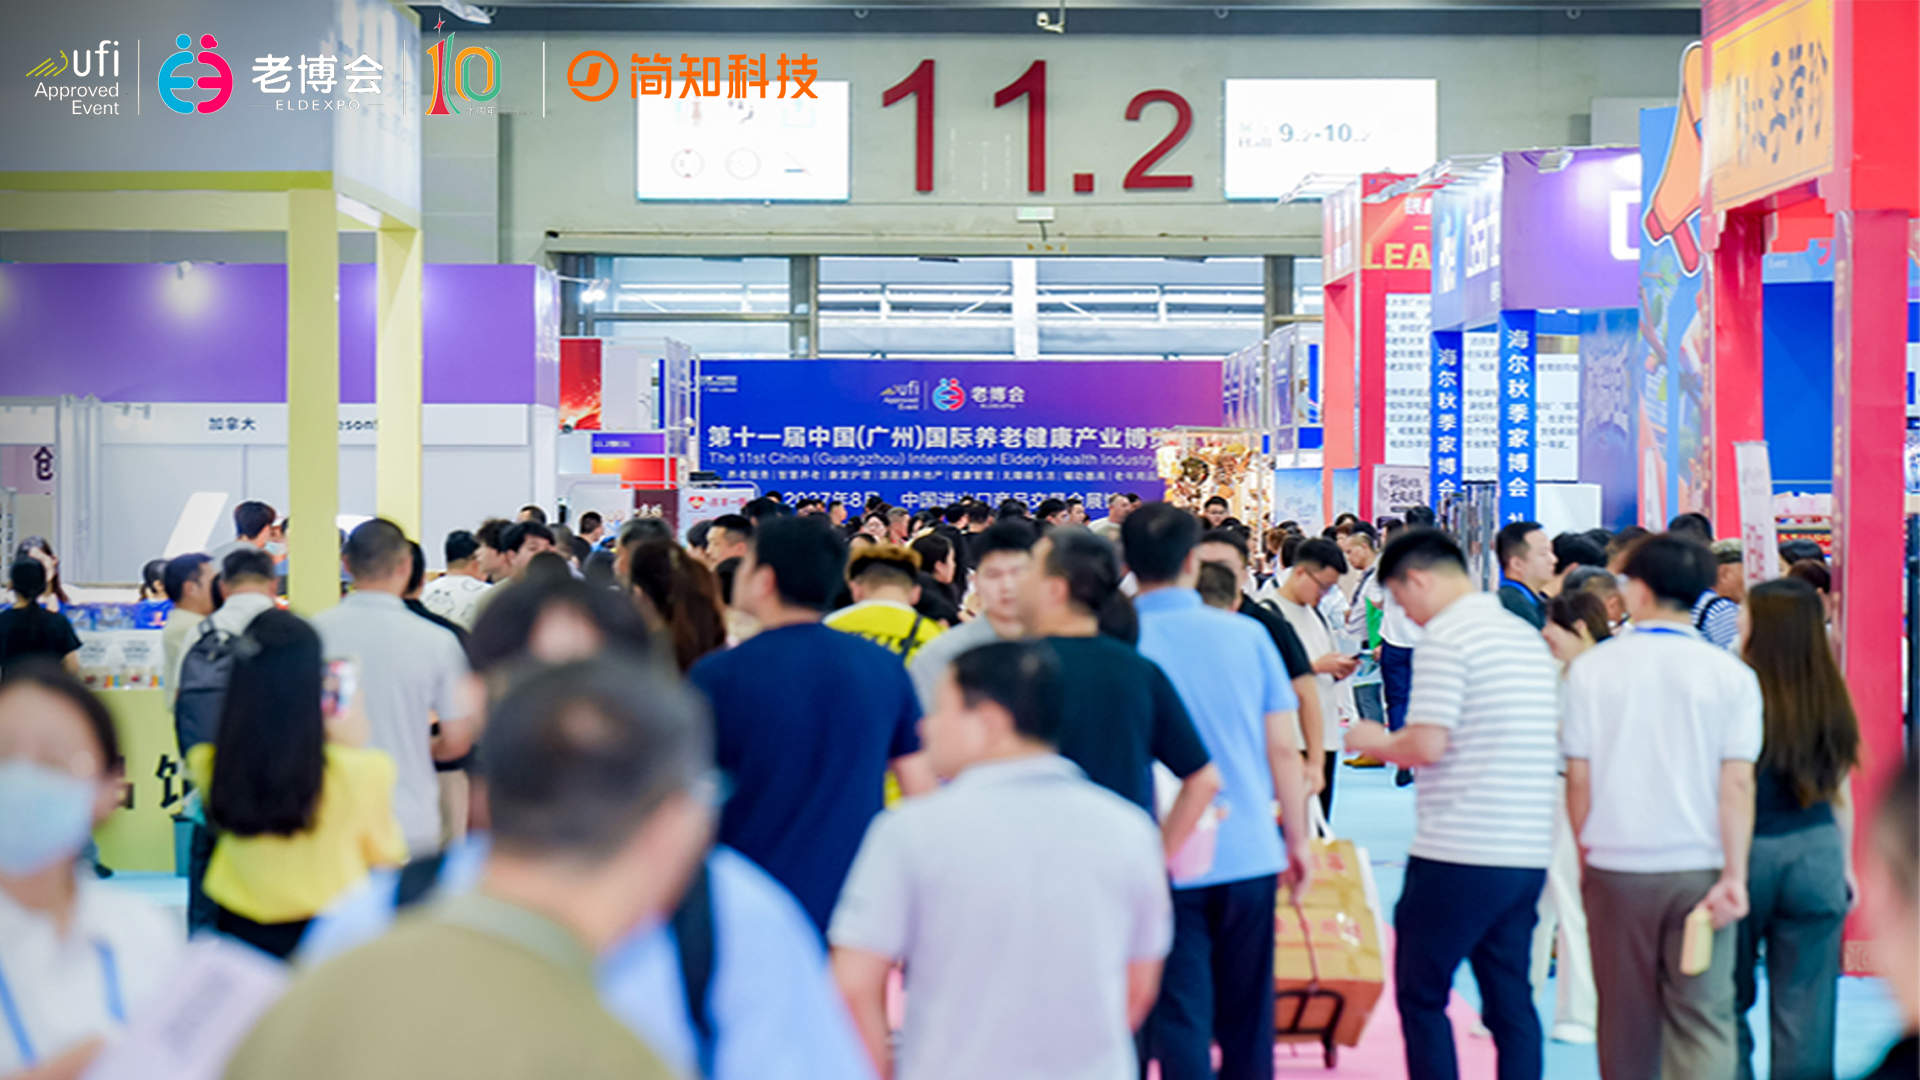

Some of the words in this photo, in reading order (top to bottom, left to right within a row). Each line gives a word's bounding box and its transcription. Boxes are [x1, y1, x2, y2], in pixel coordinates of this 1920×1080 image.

[882, 59, 1194, 193] 11.2
[208, 416, 256, 431] 加拿大
[971, 386, 1025, 403] 老博会
[1438, 349, 1458, 498] 海尔秋季家博会
[1507, 329, 1529, 497] 海尔秋季家博会
[710, 452, 735, 465] The
[739, 452, 767, 465] 11st
[768, 452, 810, 465] China
[812, 452, 905, 467] (Guangzhou)
[908, 453, 997, 465] International
[1001, 453, 1049, 468] Elderly
[1052, 453, 1098, 465] Health
